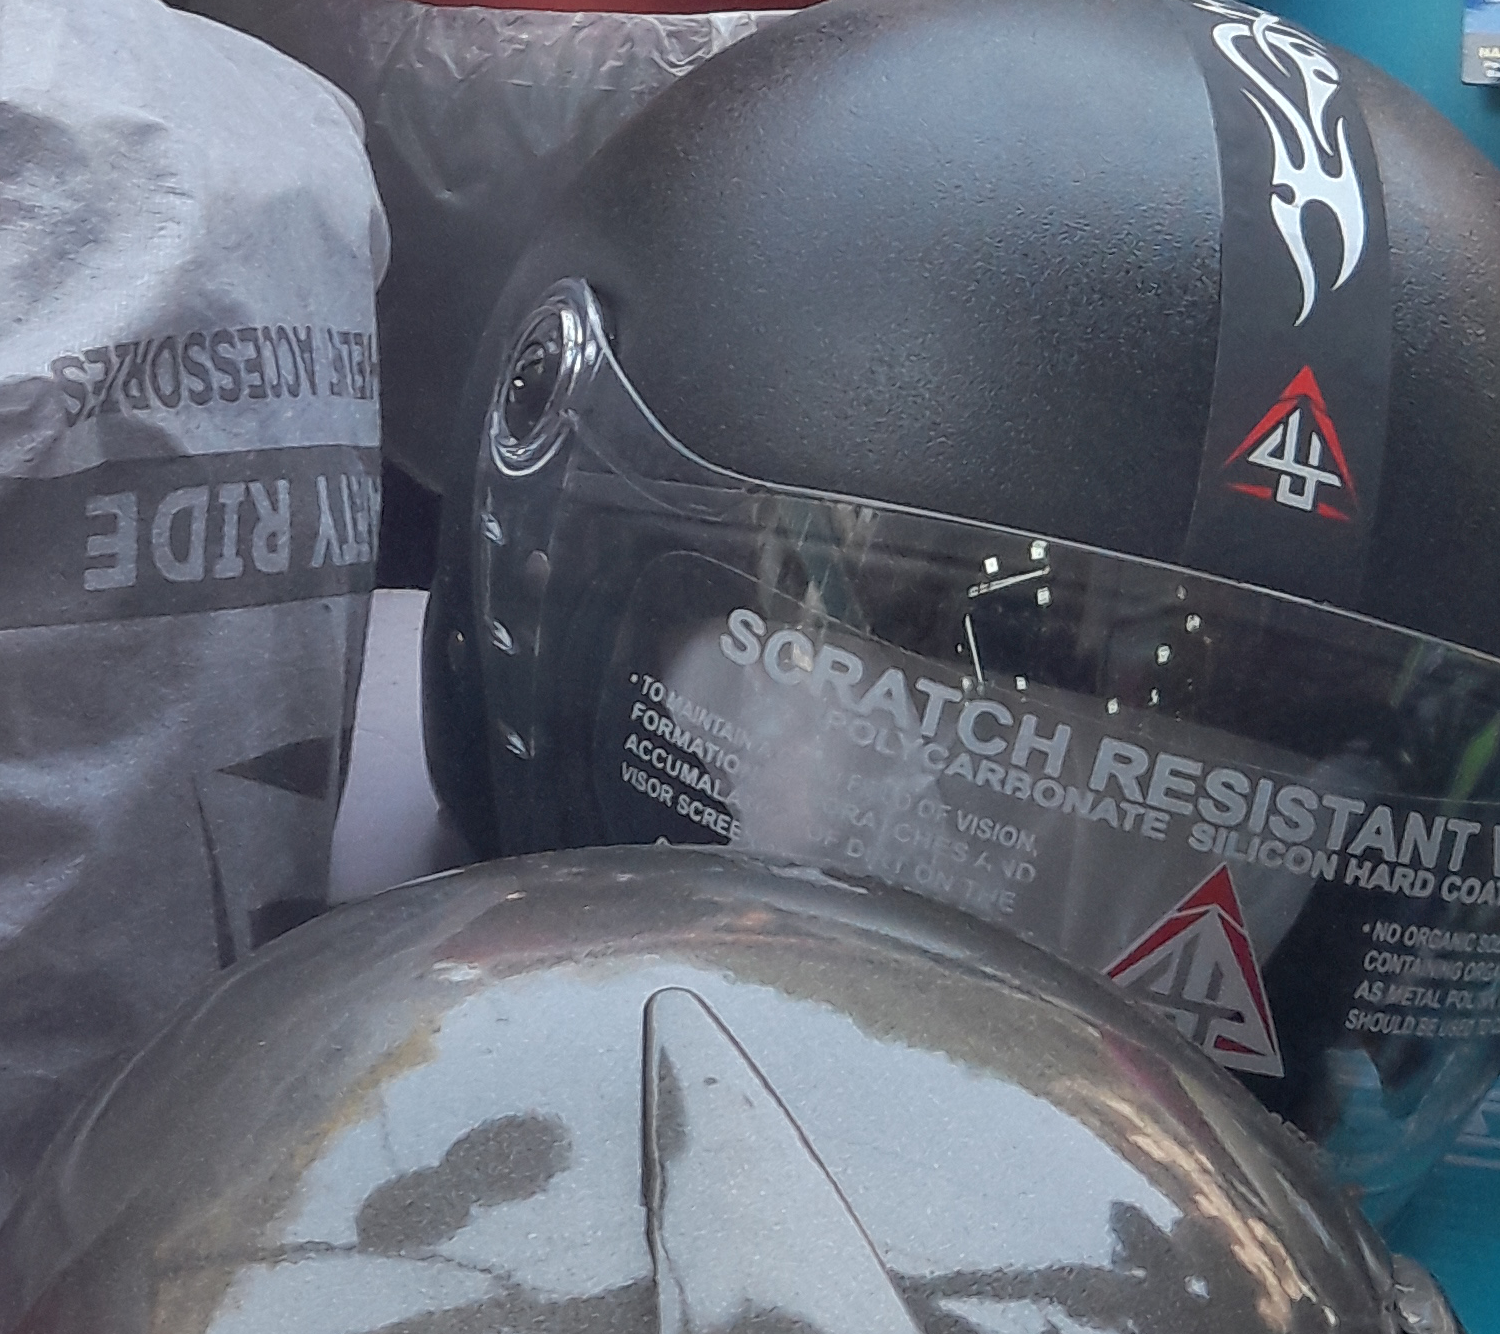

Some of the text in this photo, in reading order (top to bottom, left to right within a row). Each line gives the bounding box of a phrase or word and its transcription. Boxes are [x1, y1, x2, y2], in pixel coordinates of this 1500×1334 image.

[83, 477, 292, 592] RIDE
[623, 732, 743, 807] ACCUMALA
[629, 700, 741, 776] FORMATIO
[718, 607, 1073, 780] SCRATCH
[1087, 734, 1483, 873] RESISTANT
[620, 759, 743, 843] VISOR SCREE
[1187, 821, 1340, 881] SILICON
[1345, 857, 1436, 899] HARD
[1344, 1007, 1417, 1036] SHOULD
[1352, 978, 1385, 1003] AS
